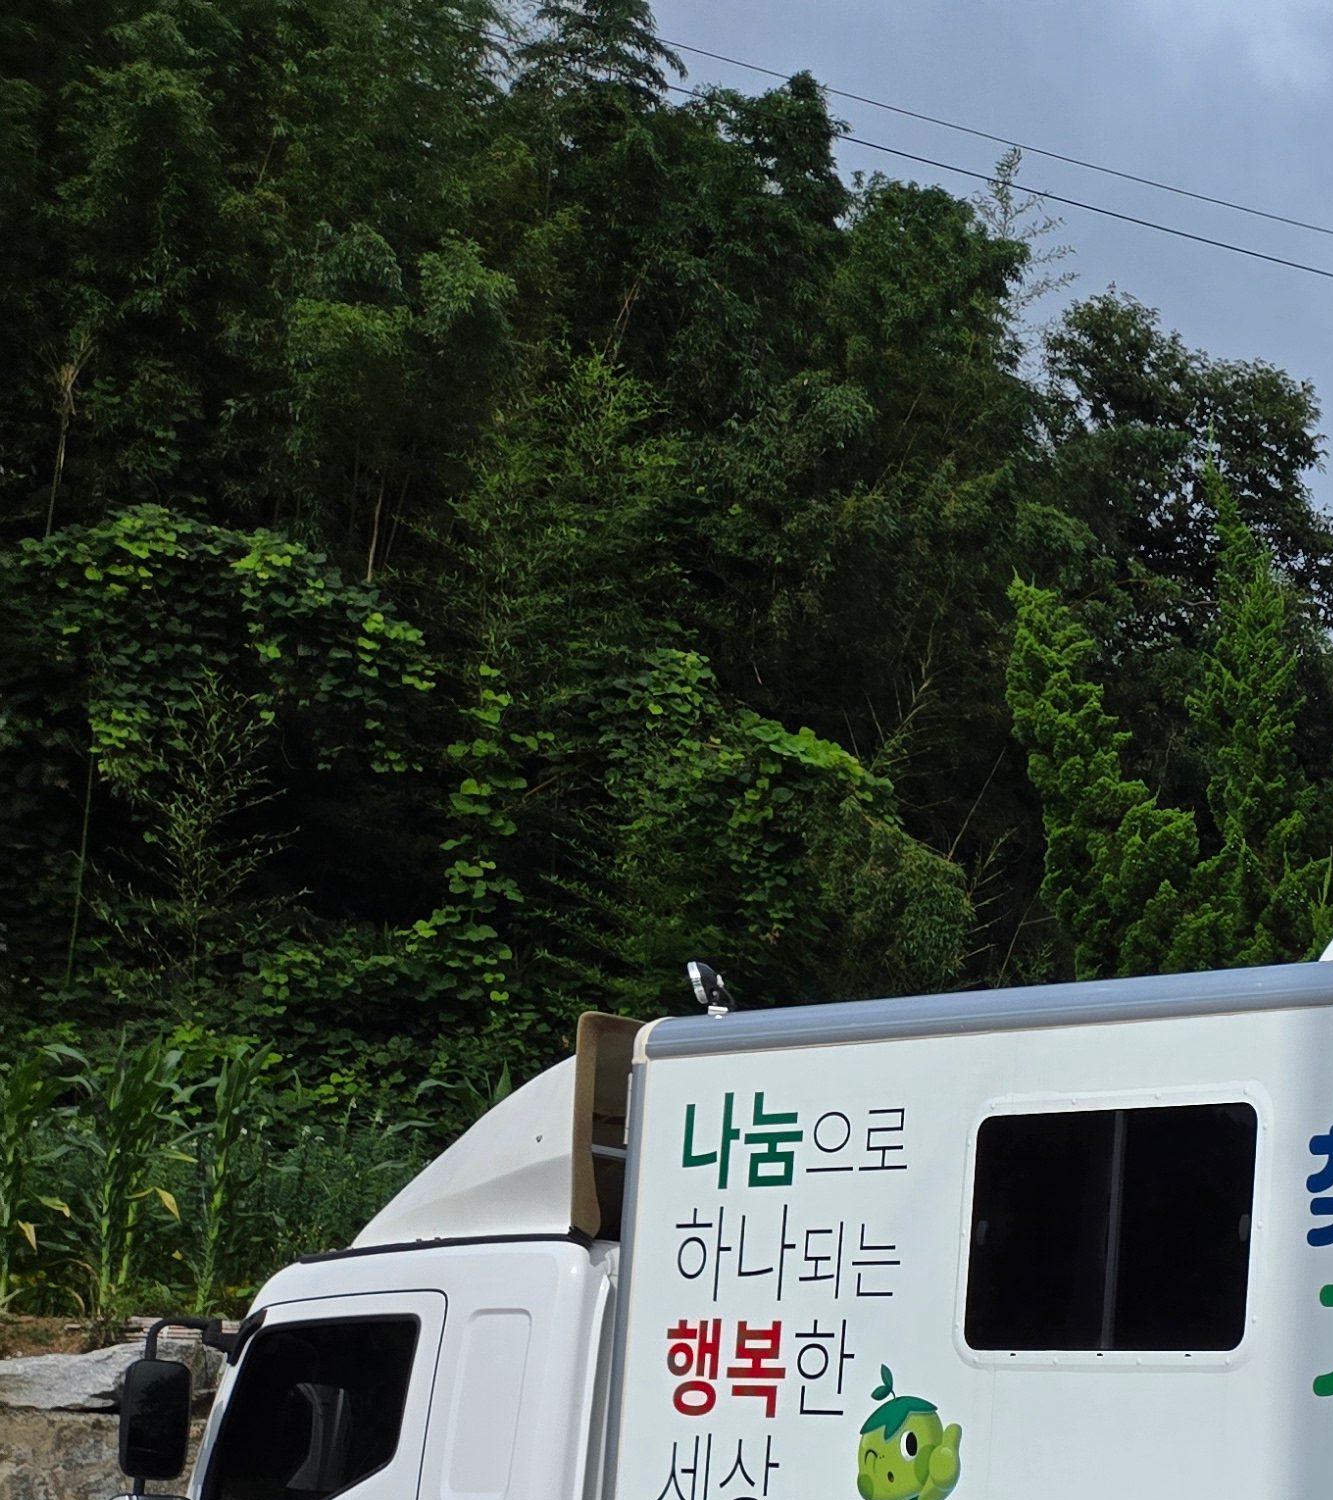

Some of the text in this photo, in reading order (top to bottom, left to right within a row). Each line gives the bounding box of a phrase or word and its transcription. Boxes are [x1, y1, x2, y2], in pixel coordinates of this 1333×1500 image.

[681, 1092, 908, 1189] 나눔으로
[676, 1204, 901, 1302] 하나되는
[666, 1318, 855, 1418] 행복한
